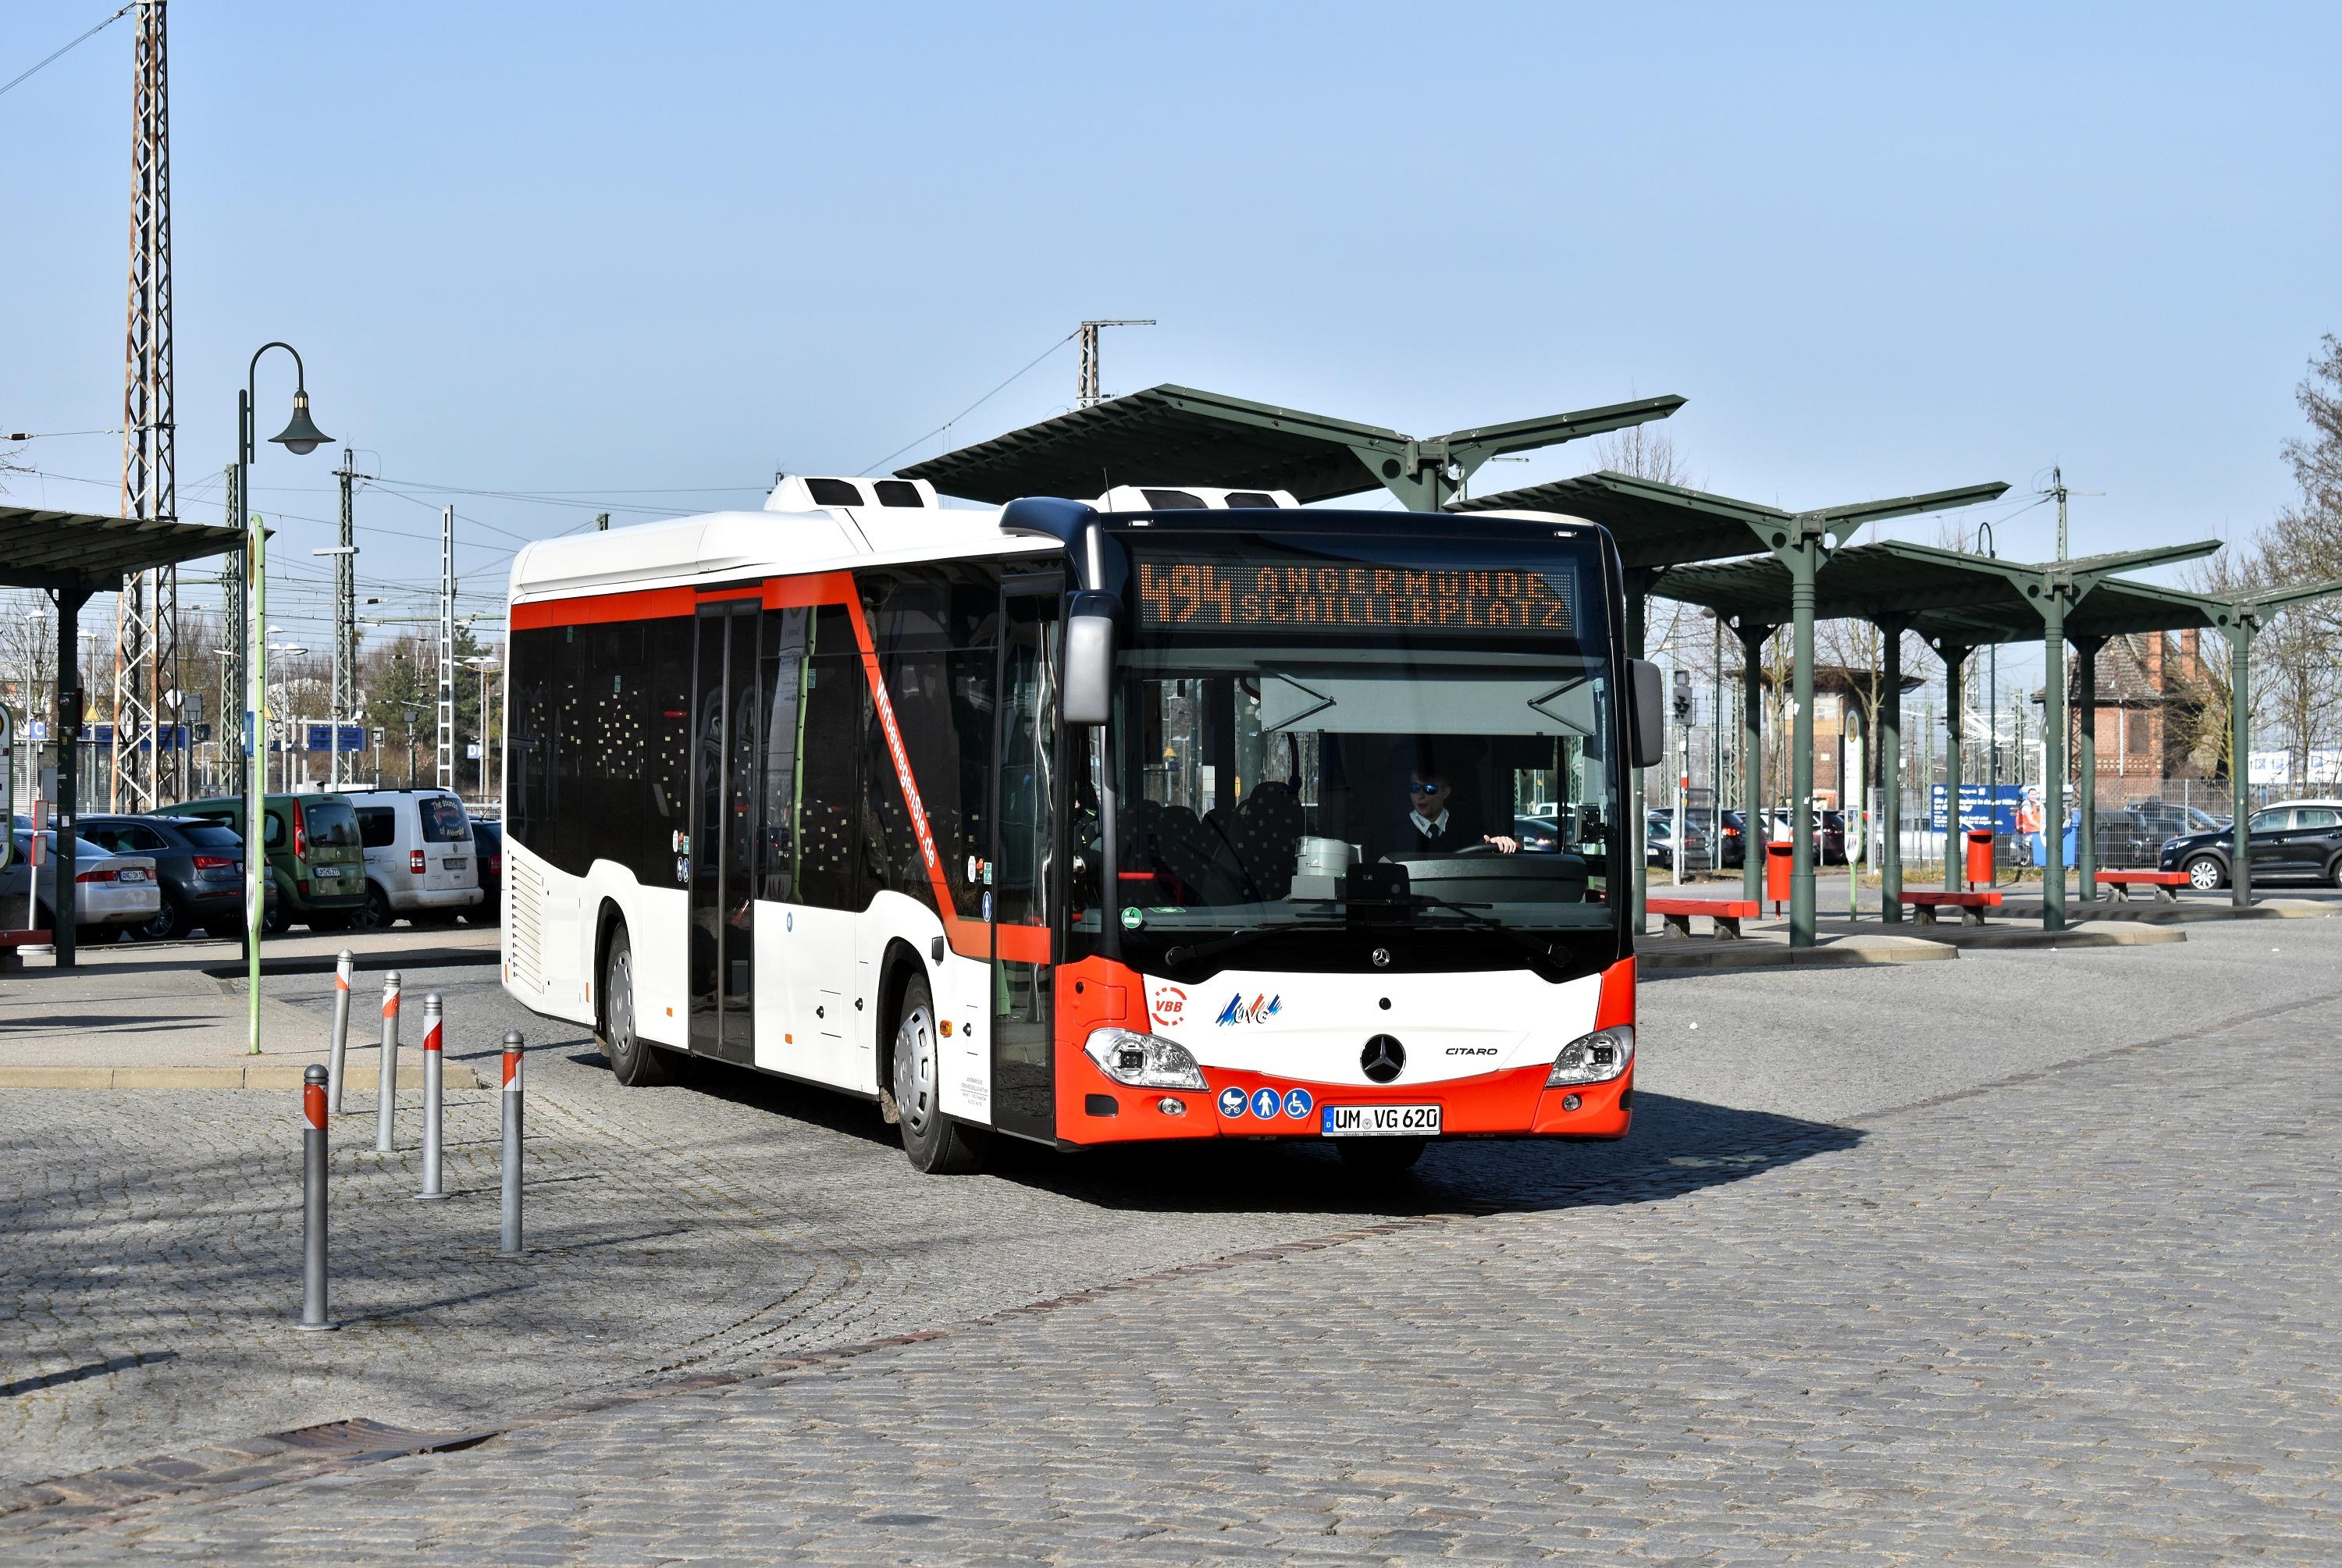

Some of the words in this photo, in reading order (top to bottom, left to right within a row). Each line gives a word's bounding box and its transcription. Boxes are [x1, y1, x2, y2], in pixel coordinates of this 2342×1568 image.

[1141, 564, 1232, 623] 494
[1257, 567, 1545, 598] ANGERMÜNDE
[1241, 594, 1563, 627] SCHILLERPLATZ
[34, 722, 44, 736] C
[876, 674, 935, 869] WirbewegenSie.de
[1129, 908, 1135, 918] 4
[1155, 1000, 1183, 1012] VBB
[1233, 1007, 1270, 1024] UVG
[1445, 1047, 1498, 1056] CITARO
[1335, 1109, 1361, 1129] UM
[1374, 1109, 1398, 1129] VG
[1402, 1108, 1437, 1128] 620
